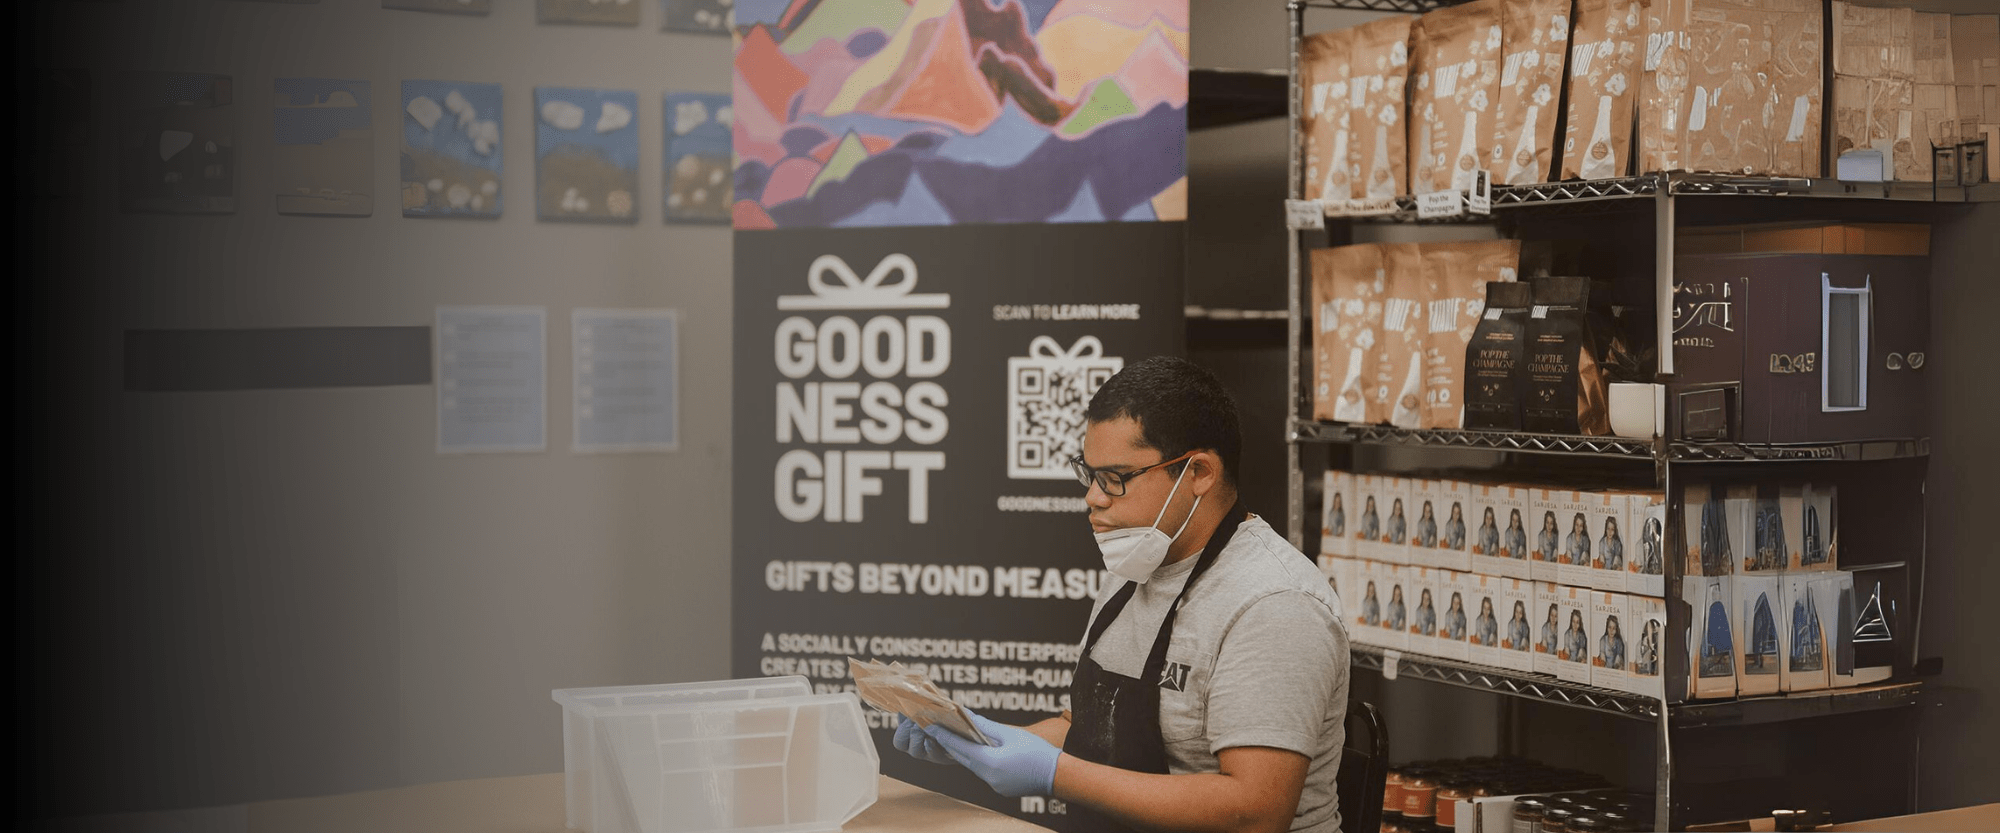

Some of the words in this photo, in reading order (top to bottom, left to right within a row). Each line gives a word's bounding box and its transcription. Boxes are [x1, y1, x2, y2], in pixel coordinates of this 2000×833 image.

[993, 303, 1031, 320] SCAN
[1032, 303, 1050, 320] TO
[1051, 303, 1099, 320] LEARN
[1100, 303, 1140, 320] MORE
[774, 315, 951, 379] GOOD
[775, 381, 949, 445] NESS
[774, 449, 946, 524] GIFT
[1563, 503, 1588, 511] SARJESA
[1595, 507, 1618, 515] SARJESA
[765, 560, 854, 594] GIFTS
[858, 562, 989, 597] BEYOND
[1595, 604, 1620, 613] SARJESA
[761, 632, 776, 652] A
[778, 633, 868, 655] SOCIALLY
[870, 636, 977, 660] CONSCIOUS
[760, 656, 845, 679] CREATES
